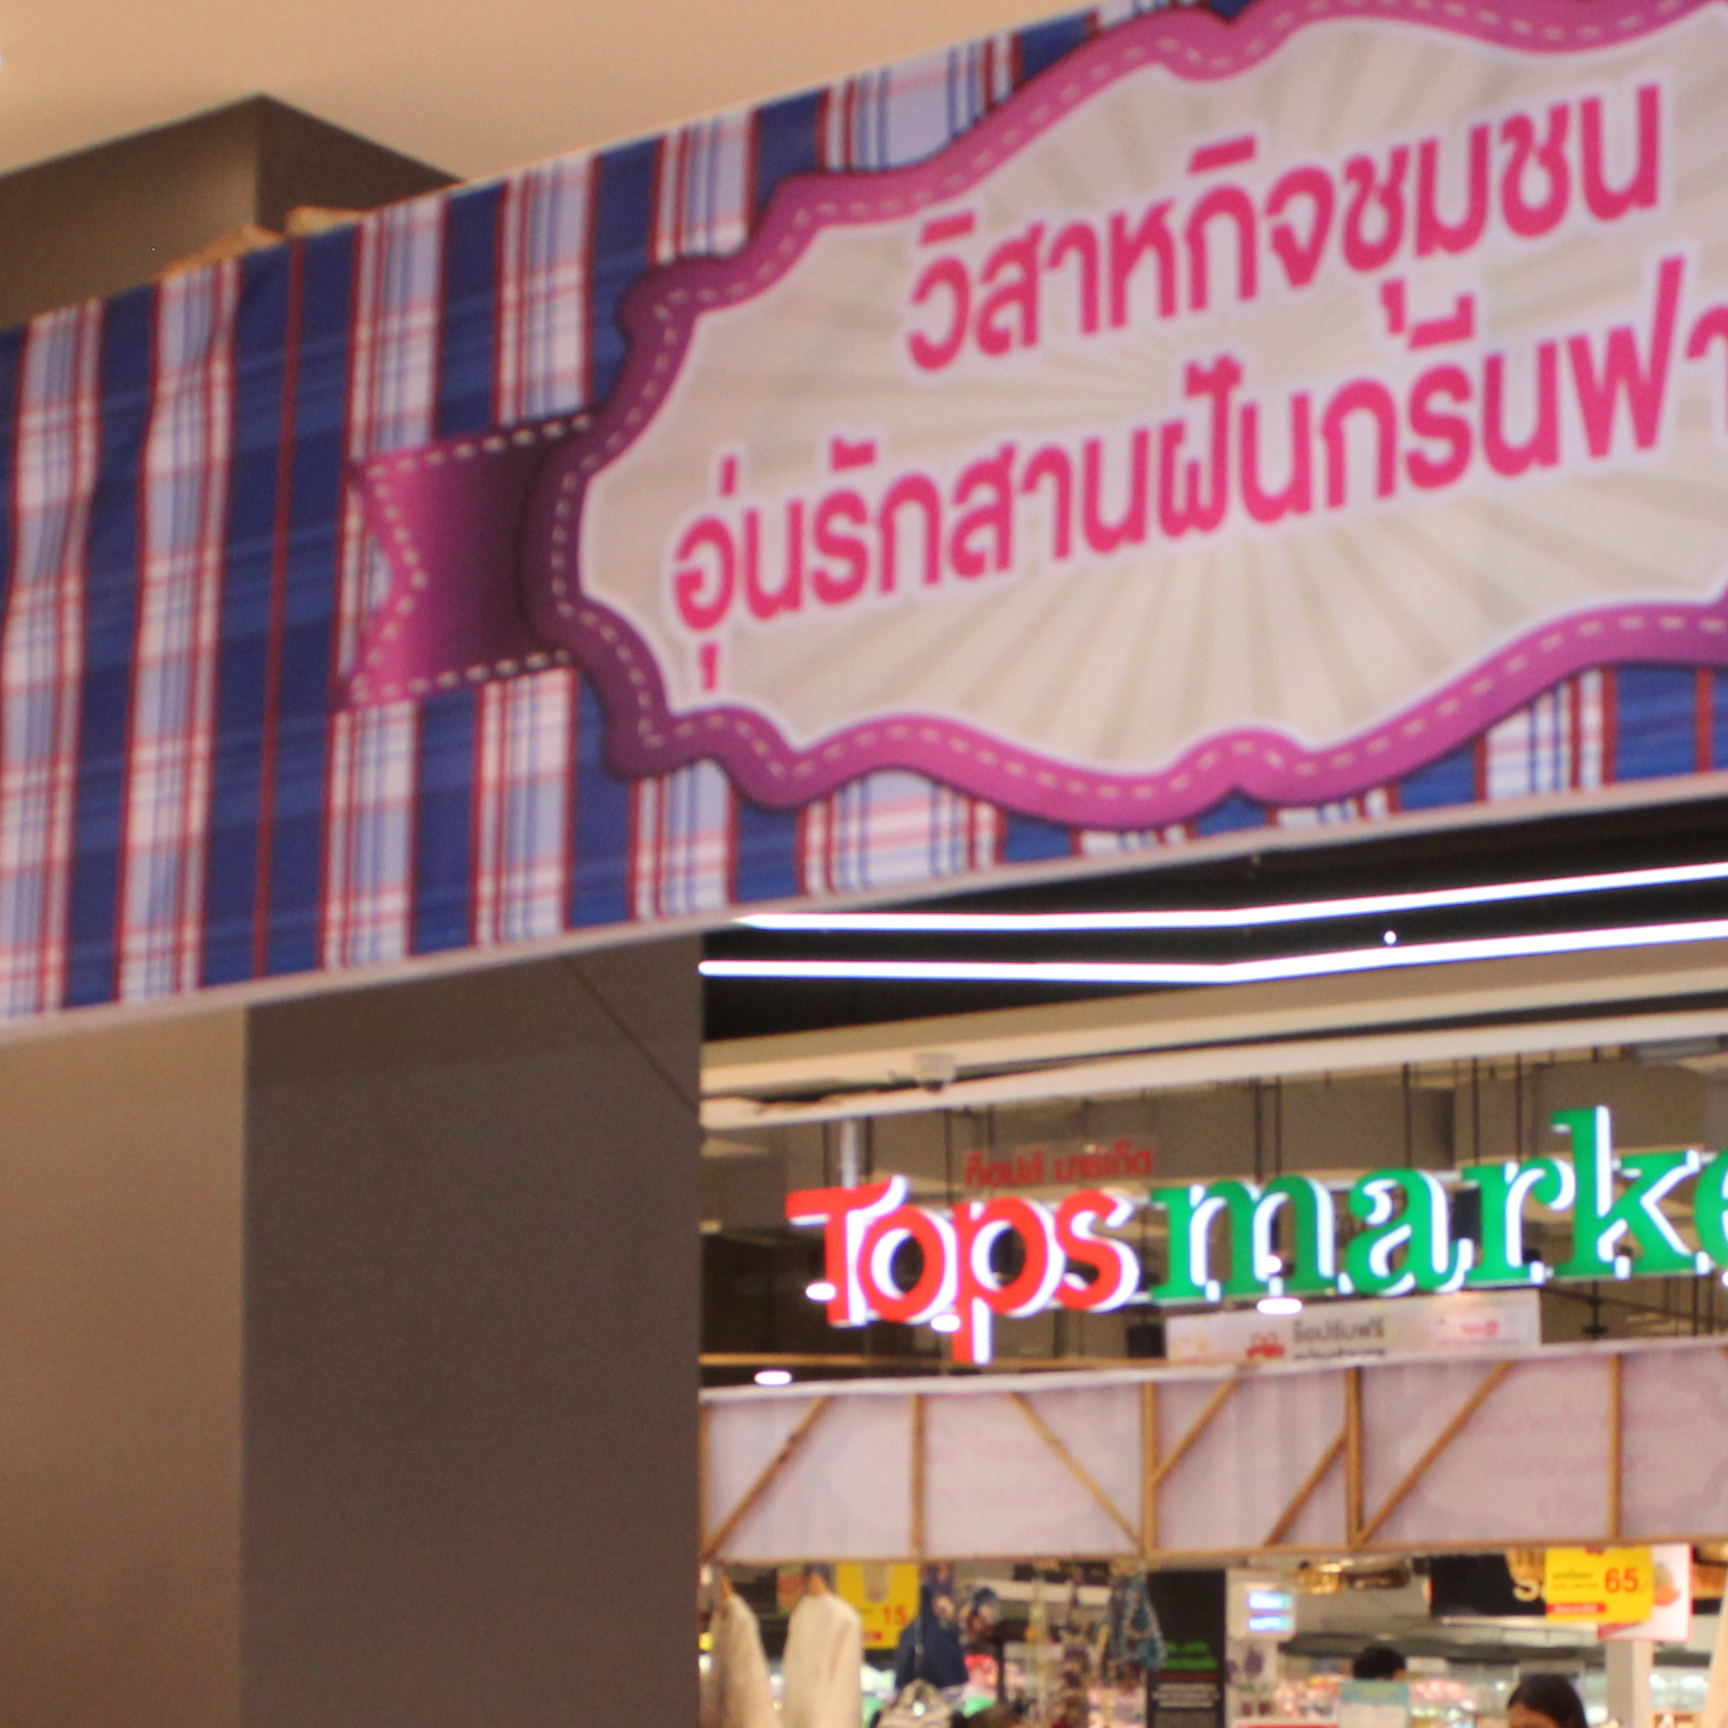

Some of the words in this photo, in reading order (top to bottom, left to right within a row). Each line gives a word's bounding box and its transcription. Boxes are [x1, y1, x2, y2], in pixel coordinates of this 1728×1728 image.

[908, 84, 1660, 372] วิสาหกิจชุมชน
[786, 1173, 1140, 1363] Tops
[1604, 1567, 1639, 1594] 65
